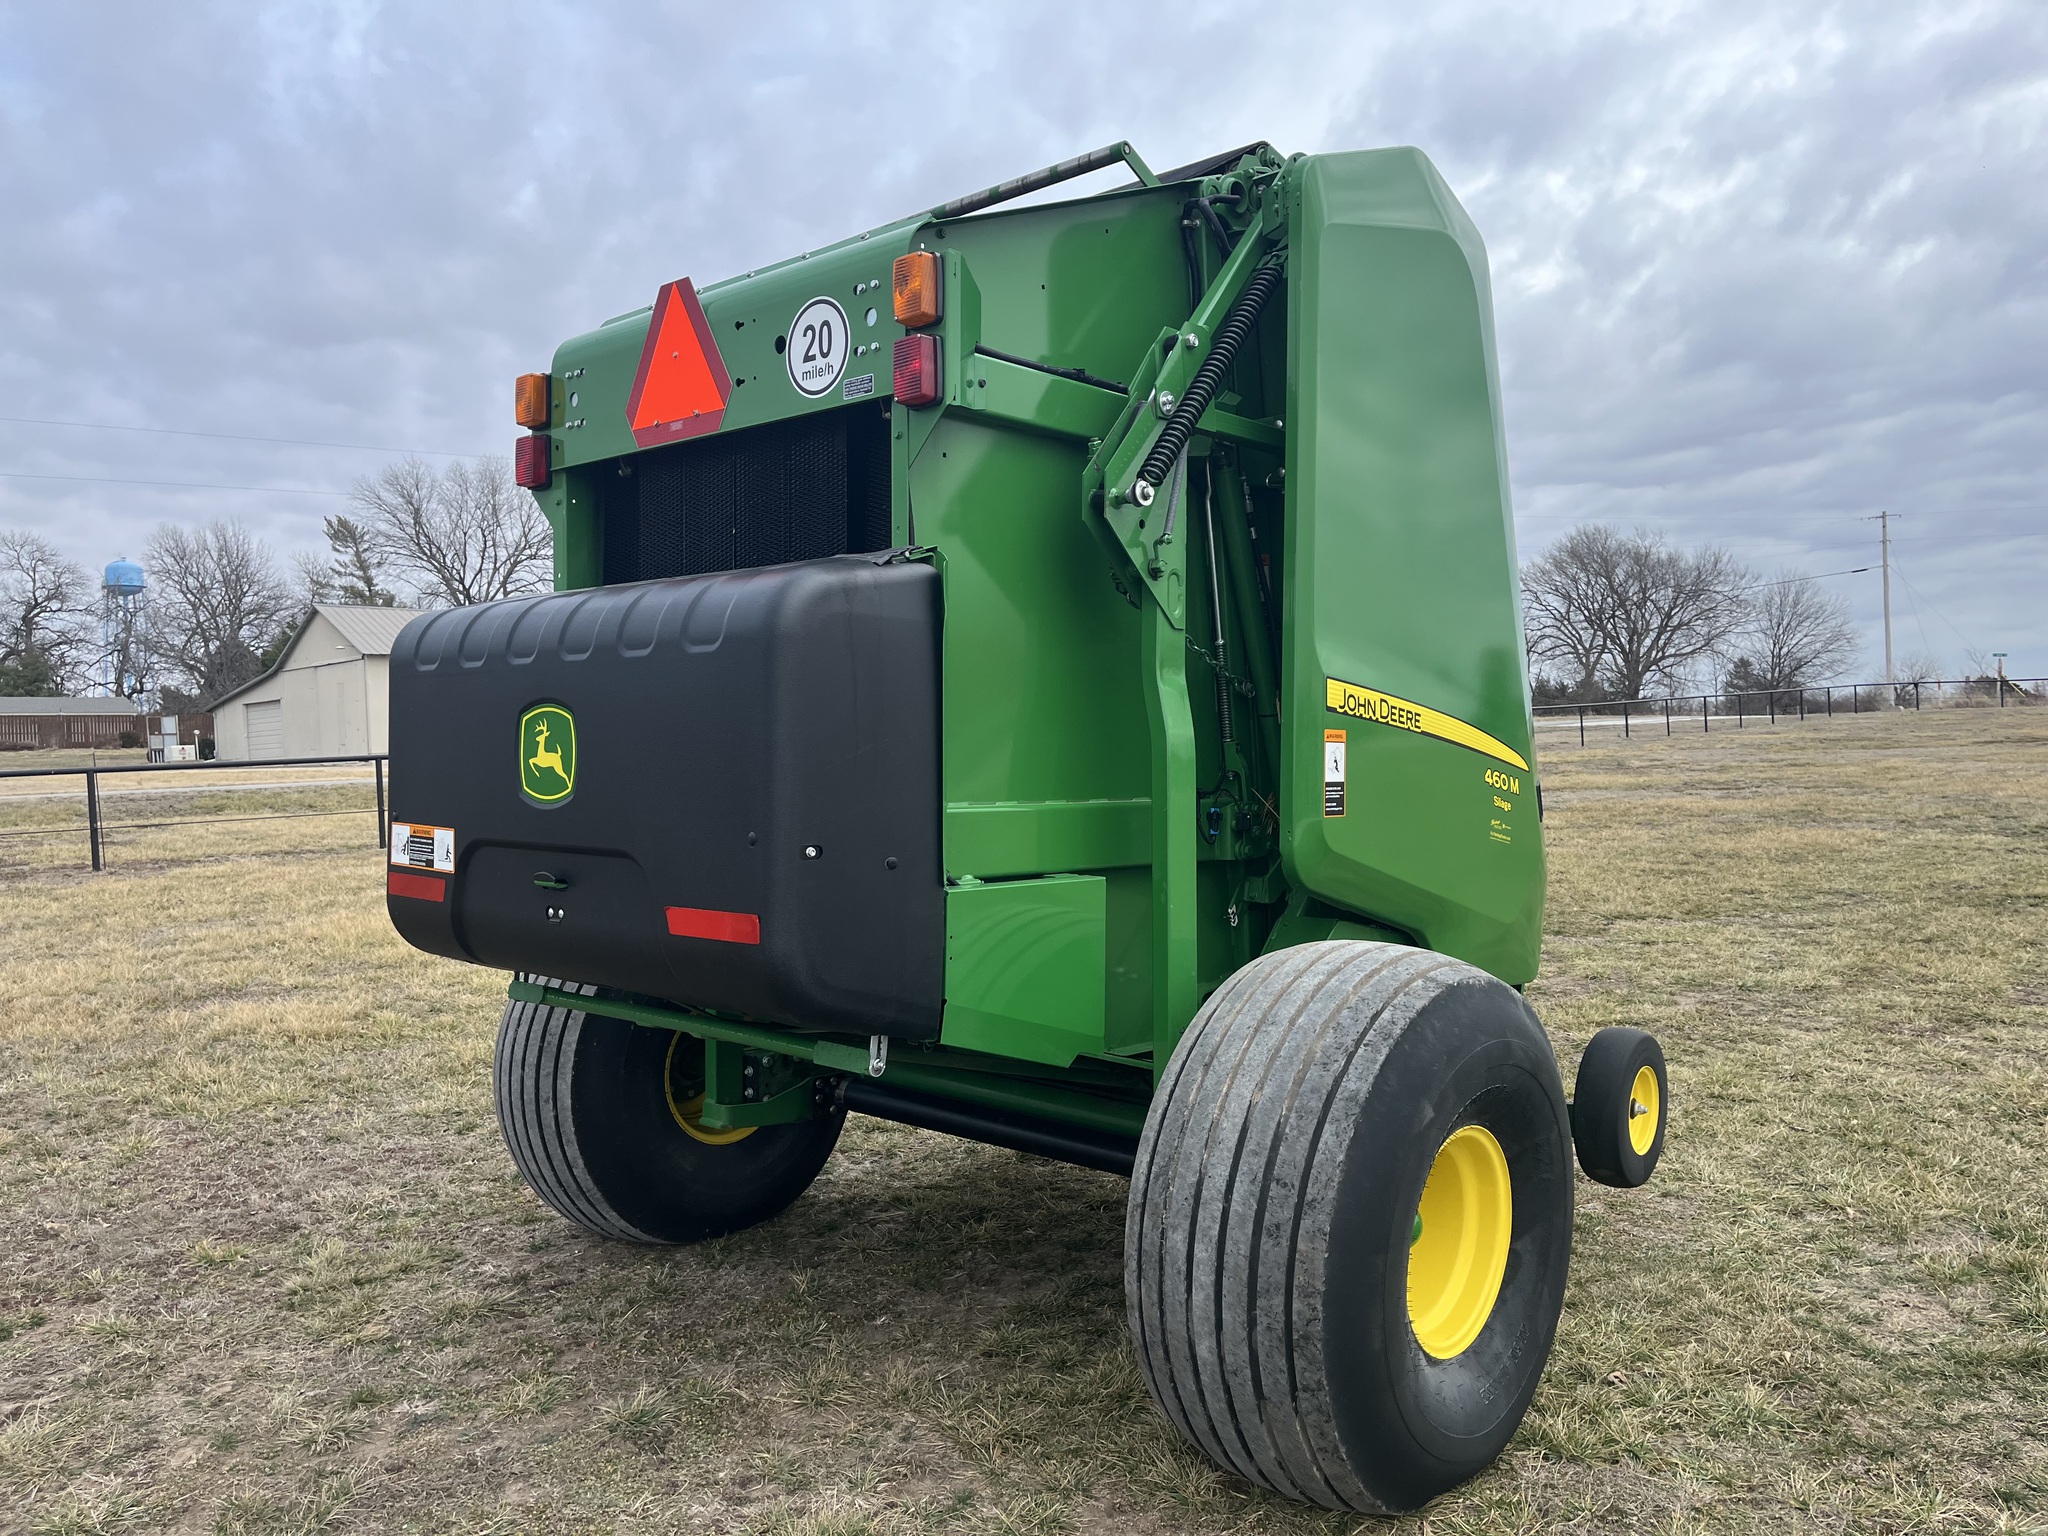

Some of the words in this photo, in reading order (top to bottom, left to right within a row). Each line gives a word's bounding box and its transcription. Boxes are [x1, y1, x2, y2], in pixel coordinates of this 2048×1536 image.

[802, 319, 833, 364] 20
[801, 361, 834, 382] mile/h
[1338, 688, 1377, 718] JOHN
[1379, 697, 1422, 730] DEERE
[1484, 767, 1509, 791] 460
[1509, 775, 1520, 796] M
[1493, 795, 1512, 812] Silage
